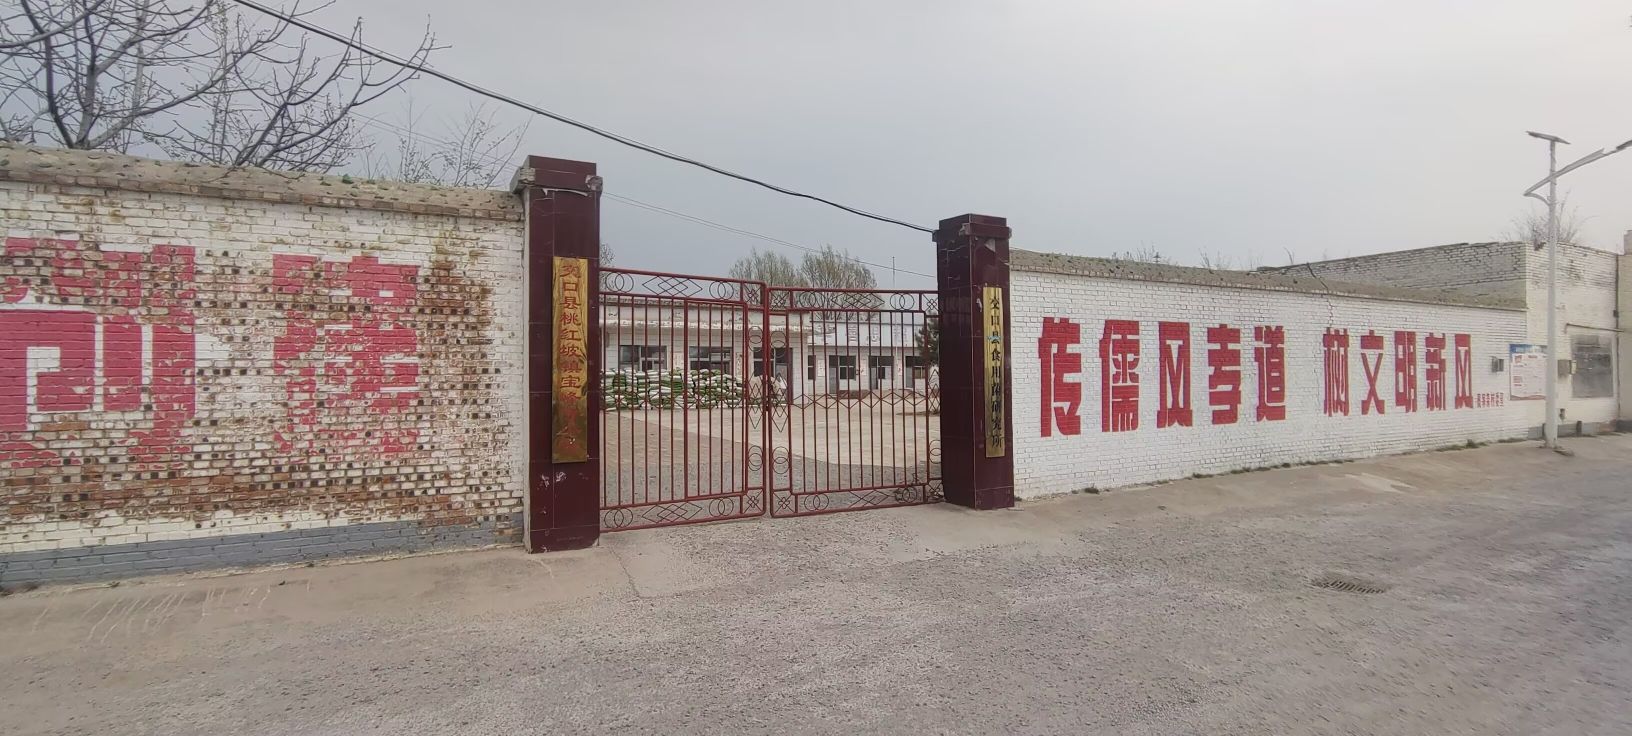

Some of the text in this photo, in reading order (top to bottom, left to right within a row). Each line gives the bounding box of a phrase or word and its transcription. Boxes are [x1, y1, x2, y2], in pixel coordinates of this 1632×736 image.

[1038, 317, 1474, 437] 传儒风孝道 树文明新风
